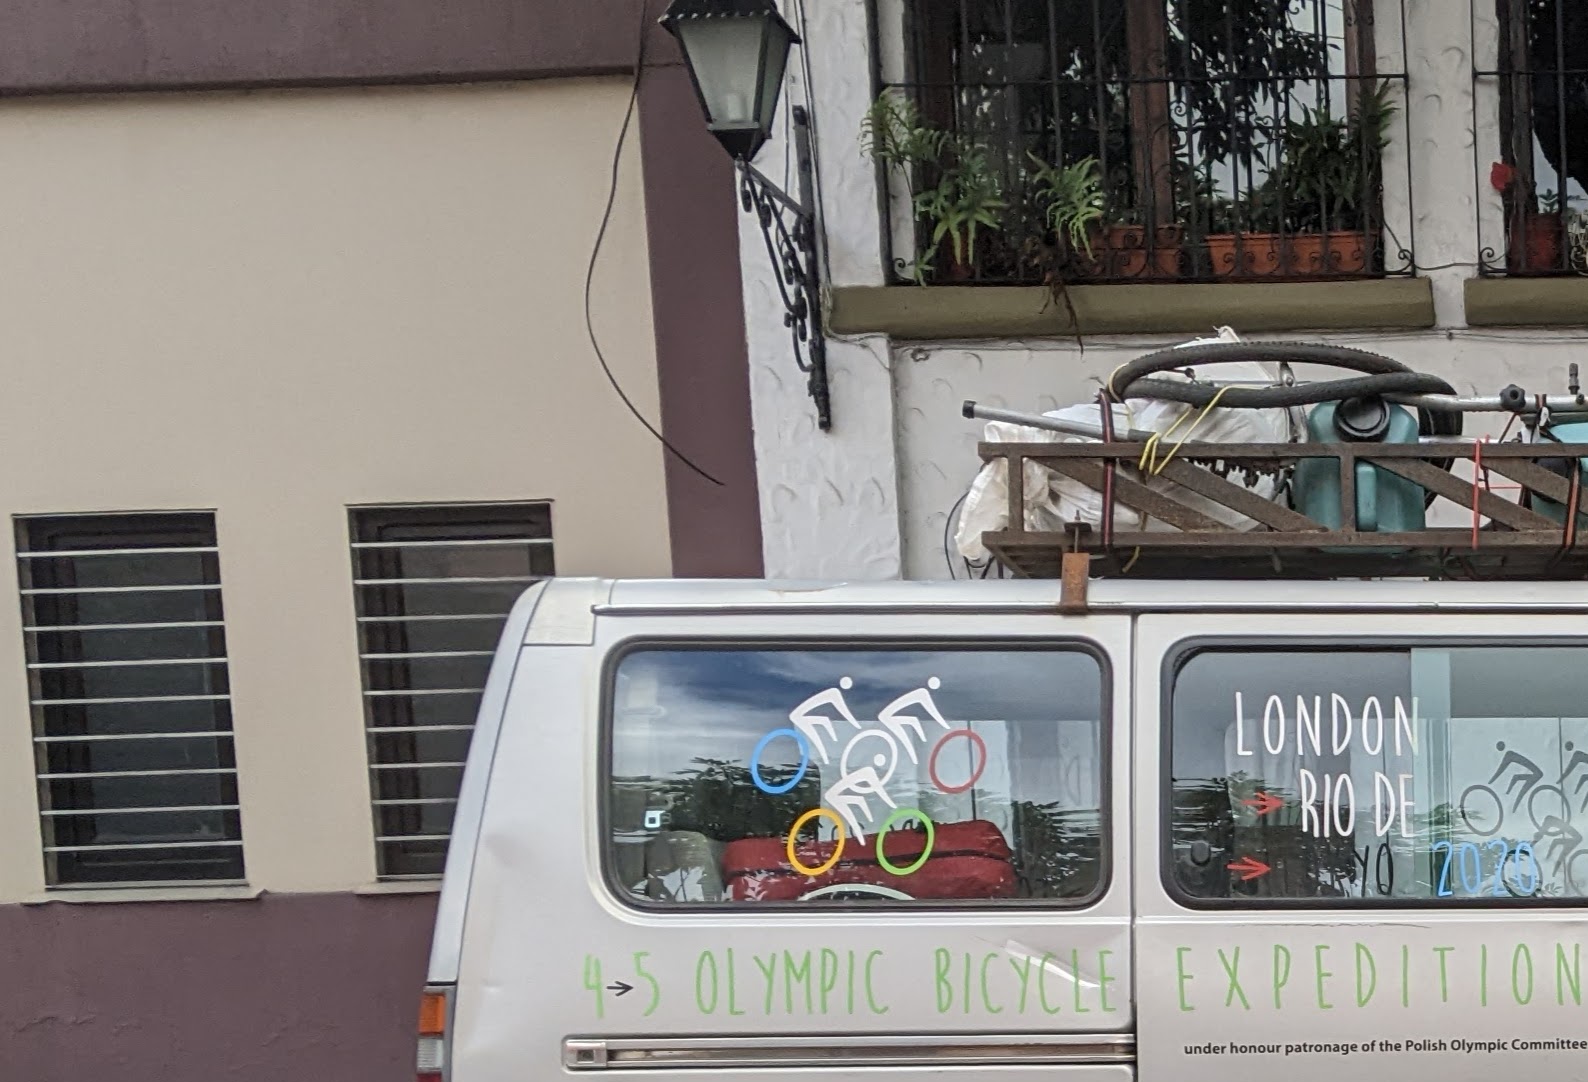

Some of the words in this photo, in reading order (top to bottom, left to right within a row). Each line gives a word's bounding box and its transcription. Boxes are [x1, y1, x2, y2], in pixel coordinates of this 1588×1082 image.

[1235, 691, 1419, 757] LONDON
[1299, 768, 1355, 838] RIO
[1374, 771, 1416, 838] DE
[1431, 840, 1539, 898] 2020
[695, 947, 890, 1017] OLYMPIC
[933, 947, 1118, 1014] BICYCLE
[1176, 942, 1582, 1012] EXPEDITION
[1184, 1042, 1227, 1055] under
[1230, 1041, 1282, 1055] honour
[1285, 1041, 1358, 1056] patronage
[1361, 1040, 1376, 1052] of
[1379, 1039, 1402, 1052] the
[1405, 1039, 1447, 1052] Polish
[1450, 1038, 1508, 1054] Olympic
[1511, 1037, 1588, 1051] Committee
